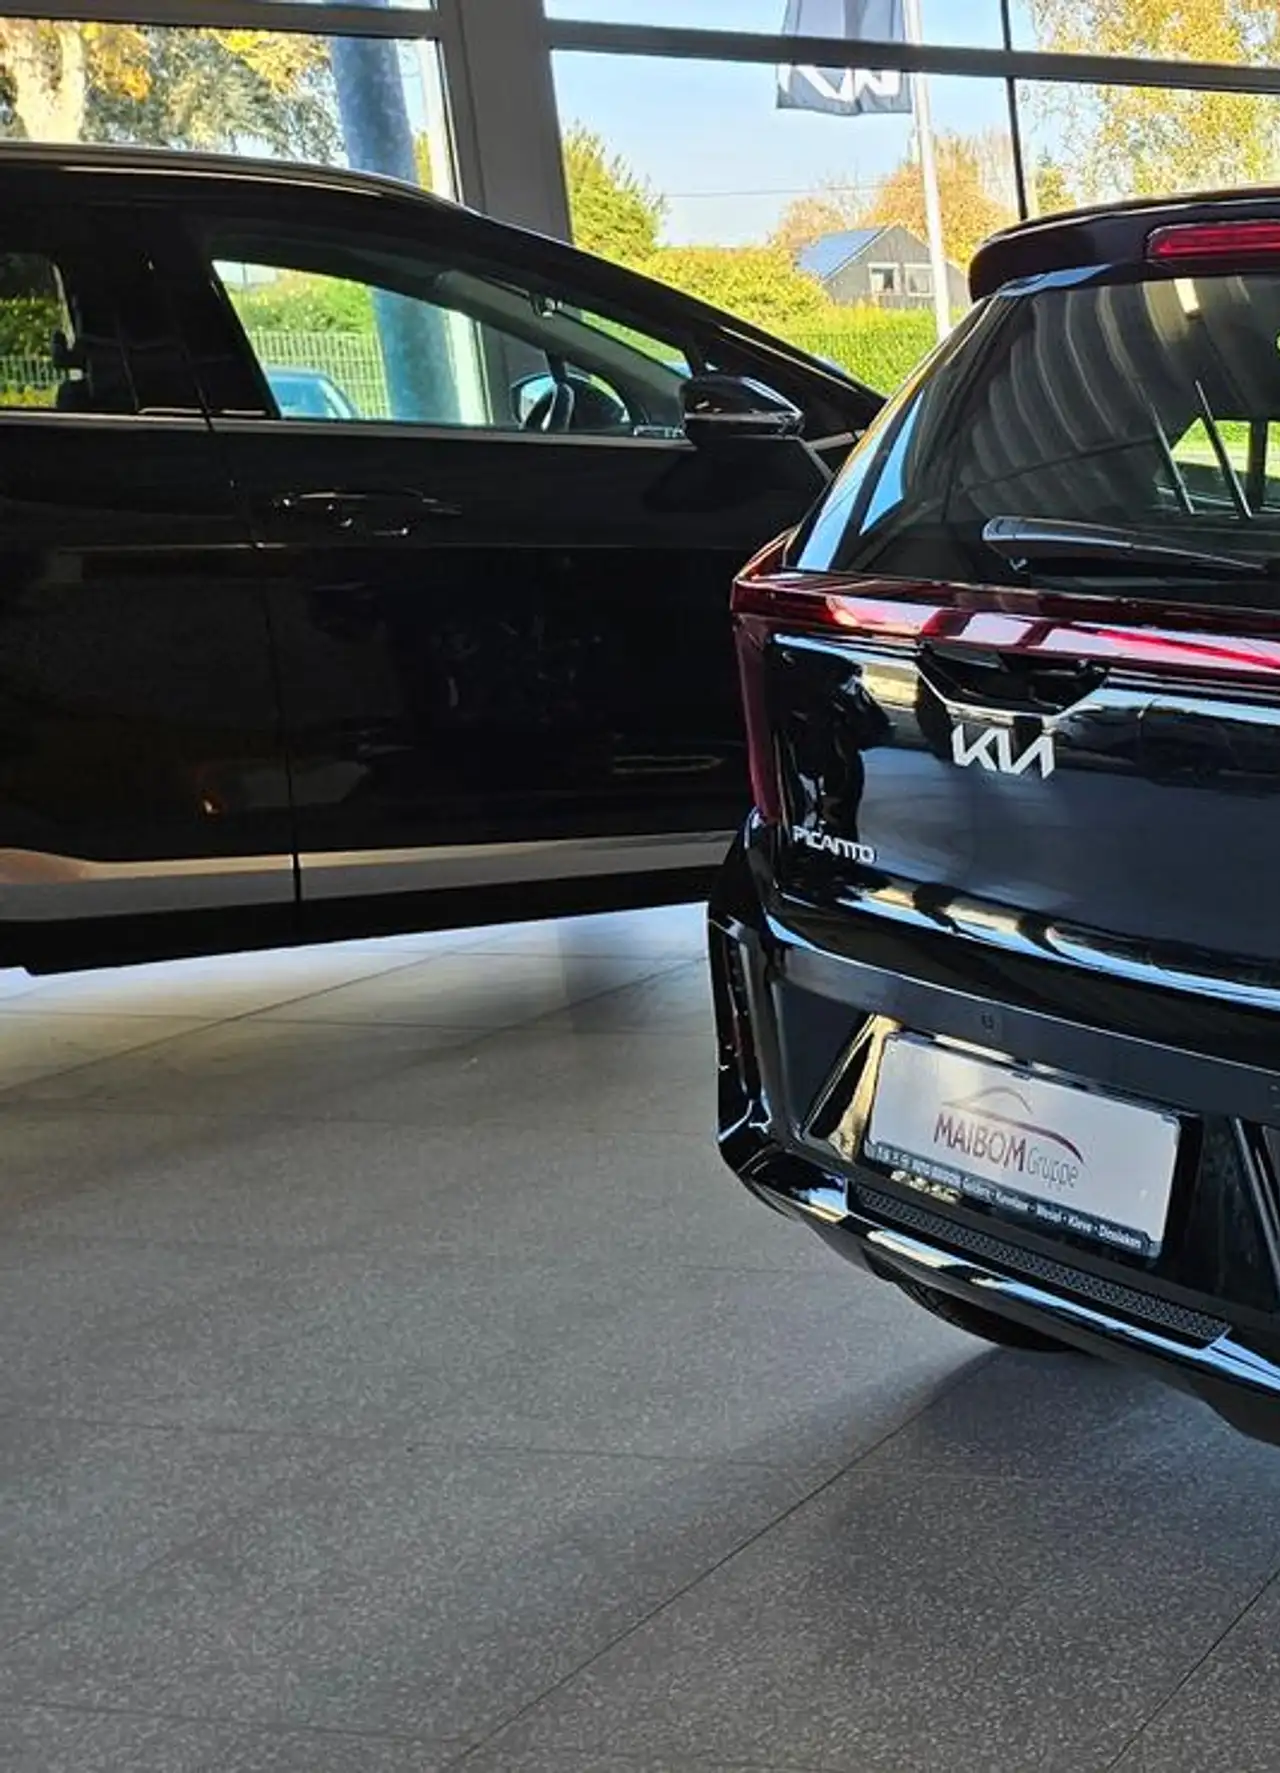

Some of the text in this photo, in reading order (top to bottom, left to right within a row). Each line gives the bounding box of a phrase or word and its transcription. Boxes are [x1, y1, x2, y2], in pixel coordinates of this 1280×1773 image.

[951, 724, 1056, 779] KIA
[792, 825, 877, 865] PICANTO
[933, 1112, 1026, 1172] MAIBOM
